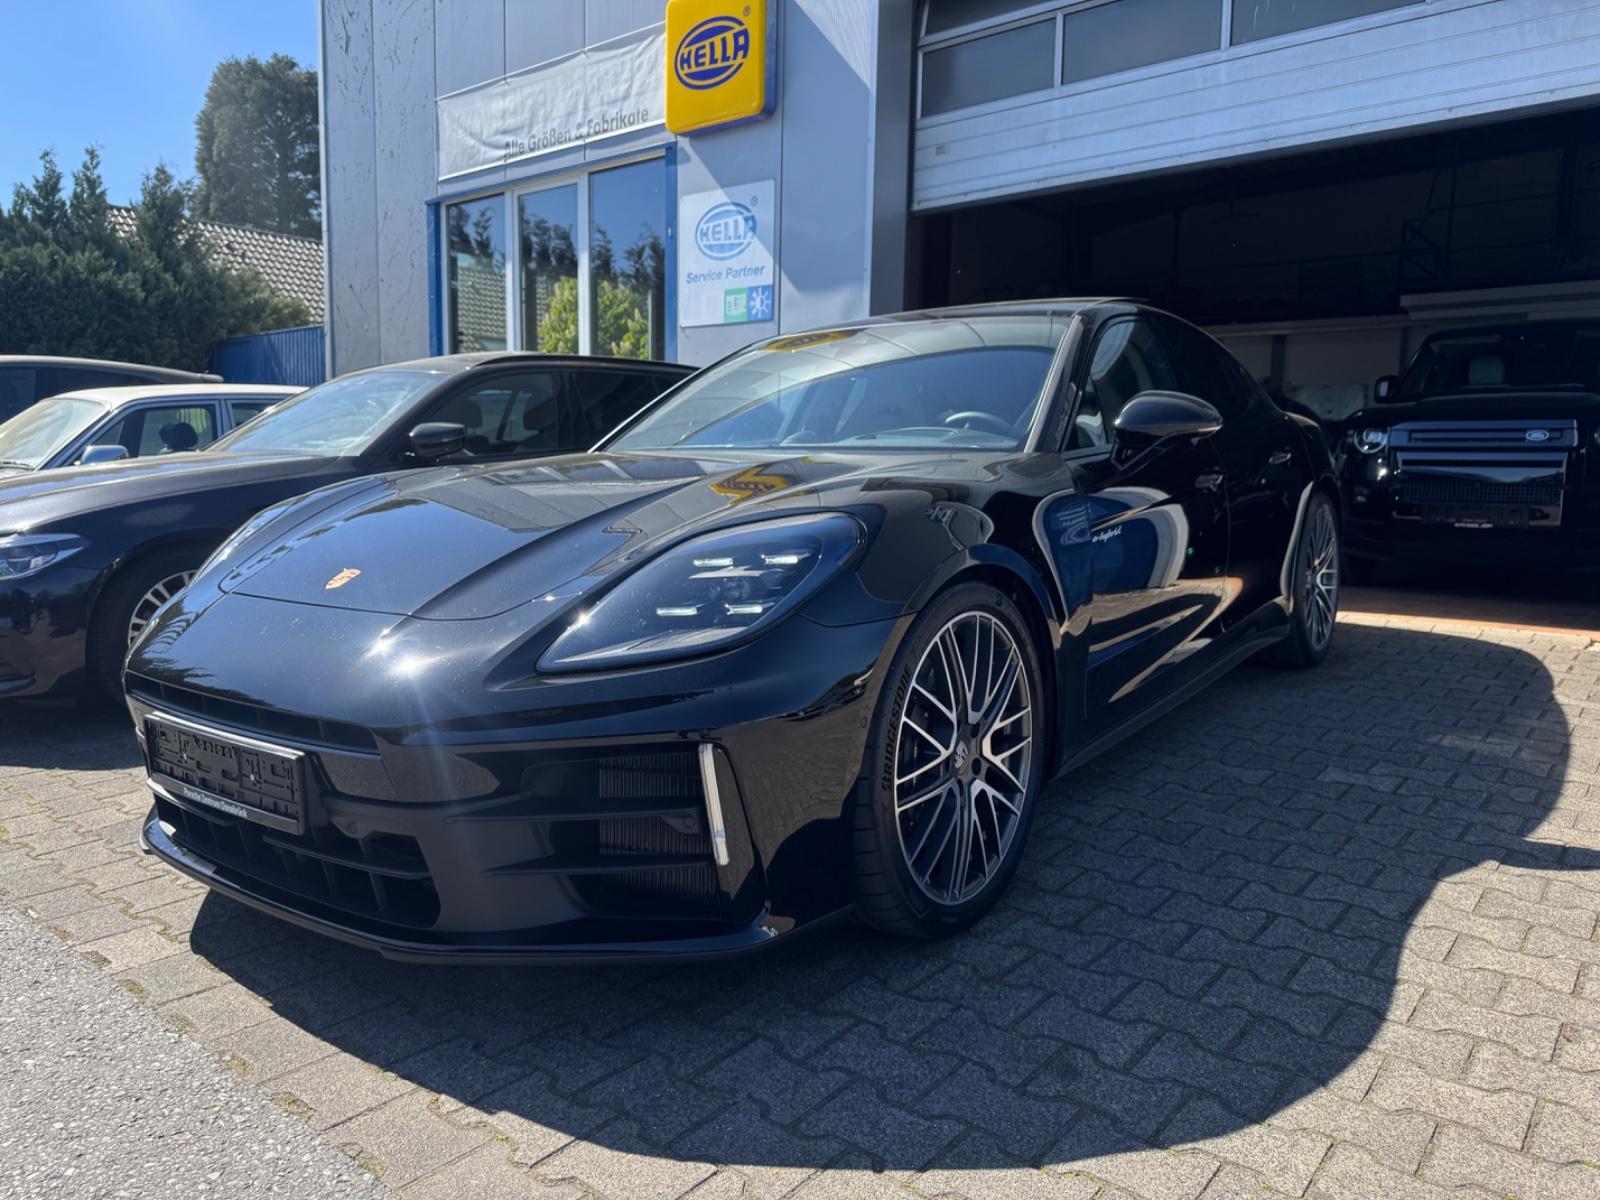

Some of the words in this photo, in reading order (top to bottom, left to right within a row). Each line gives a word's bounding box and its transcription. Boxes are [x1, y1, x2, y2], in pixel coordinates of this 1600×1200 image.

[679, 28, 750, 71] HELLA
[504, 138, 525, 160] Alle
[528, 128, 571, 151] Größen
[586, 107, 649, 138] Fabrikate
[699, 214, 757, 243] HELLA
[686, 271, 723, 284] Service
[725, 264, 766, 280] Partner
[881, 663, 912, 792] BRIDGESTONE
